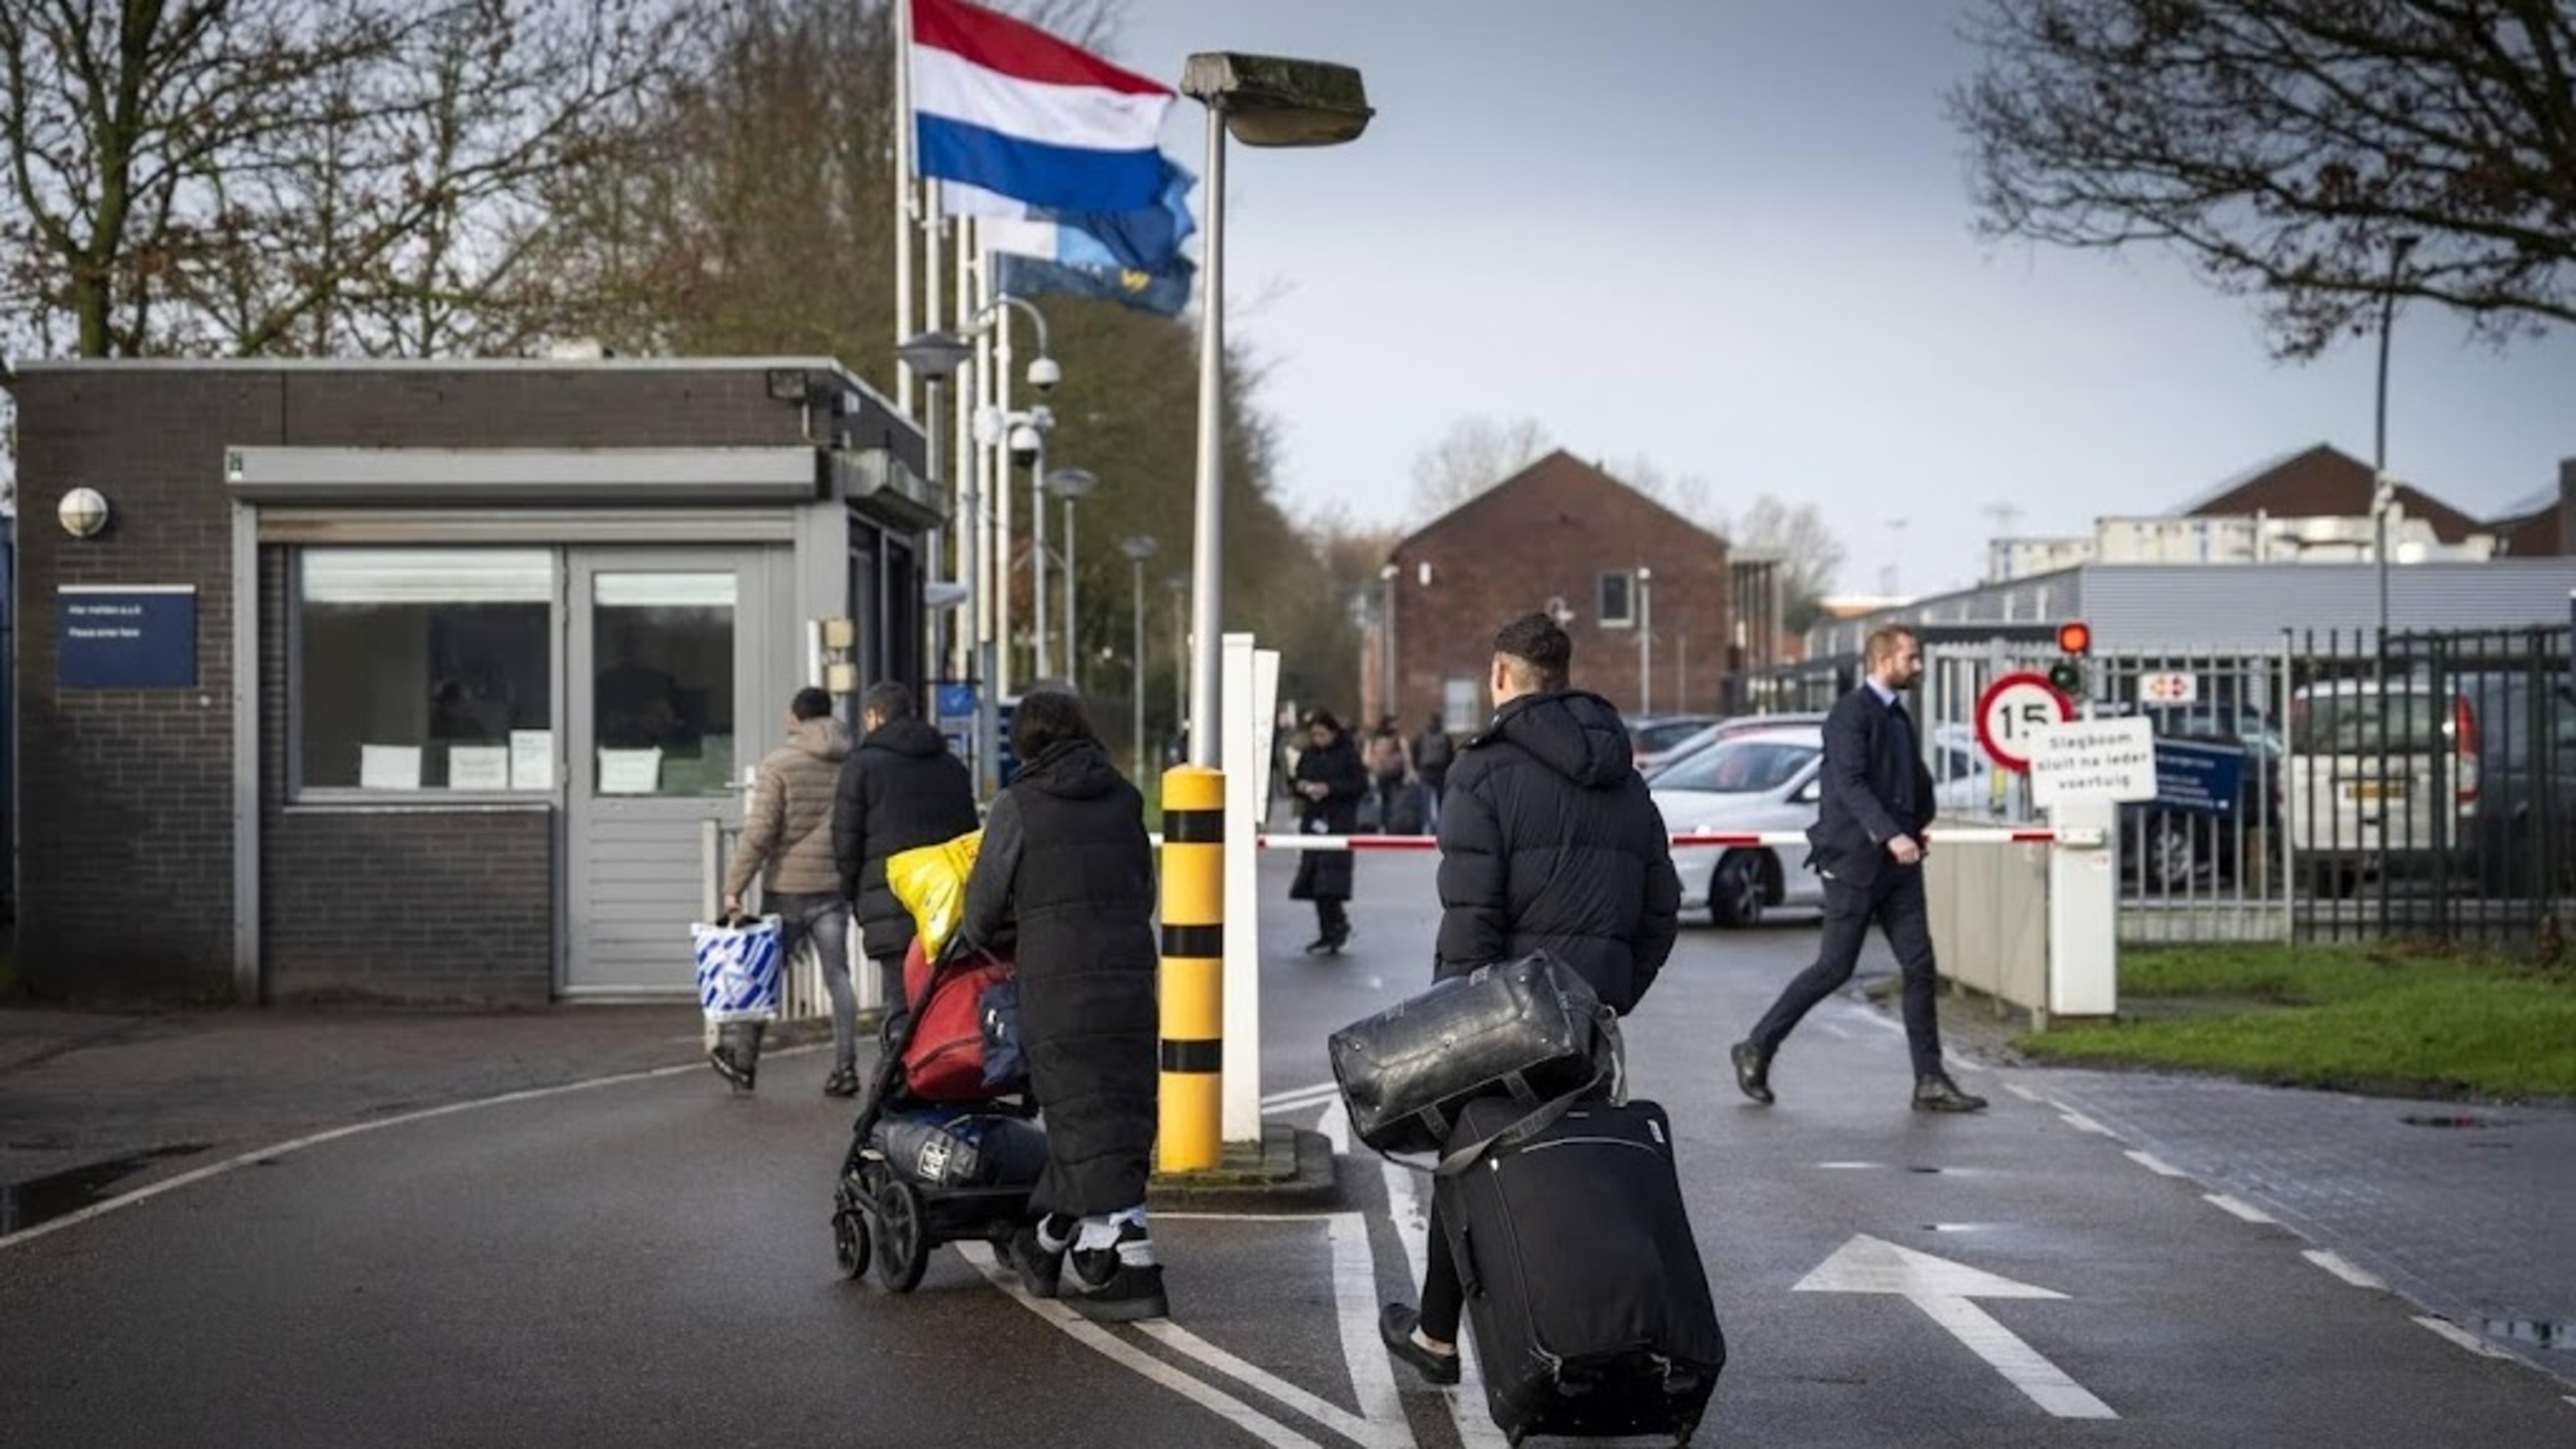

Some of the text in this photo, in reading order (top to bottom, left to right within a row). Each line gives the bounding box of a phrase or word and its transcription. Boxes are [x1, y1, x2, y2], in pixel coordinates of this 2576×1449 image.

[2000, 704, 2049, 739] 15
[2049, 733, 2133, 751] Slagboom
[2037, 757, 2074, 771] sluit
[2080, 757, 2100, 767] na
[2106, 753, 2148, 765] ieder
[2058, 773, 2130, 790] voertuig
